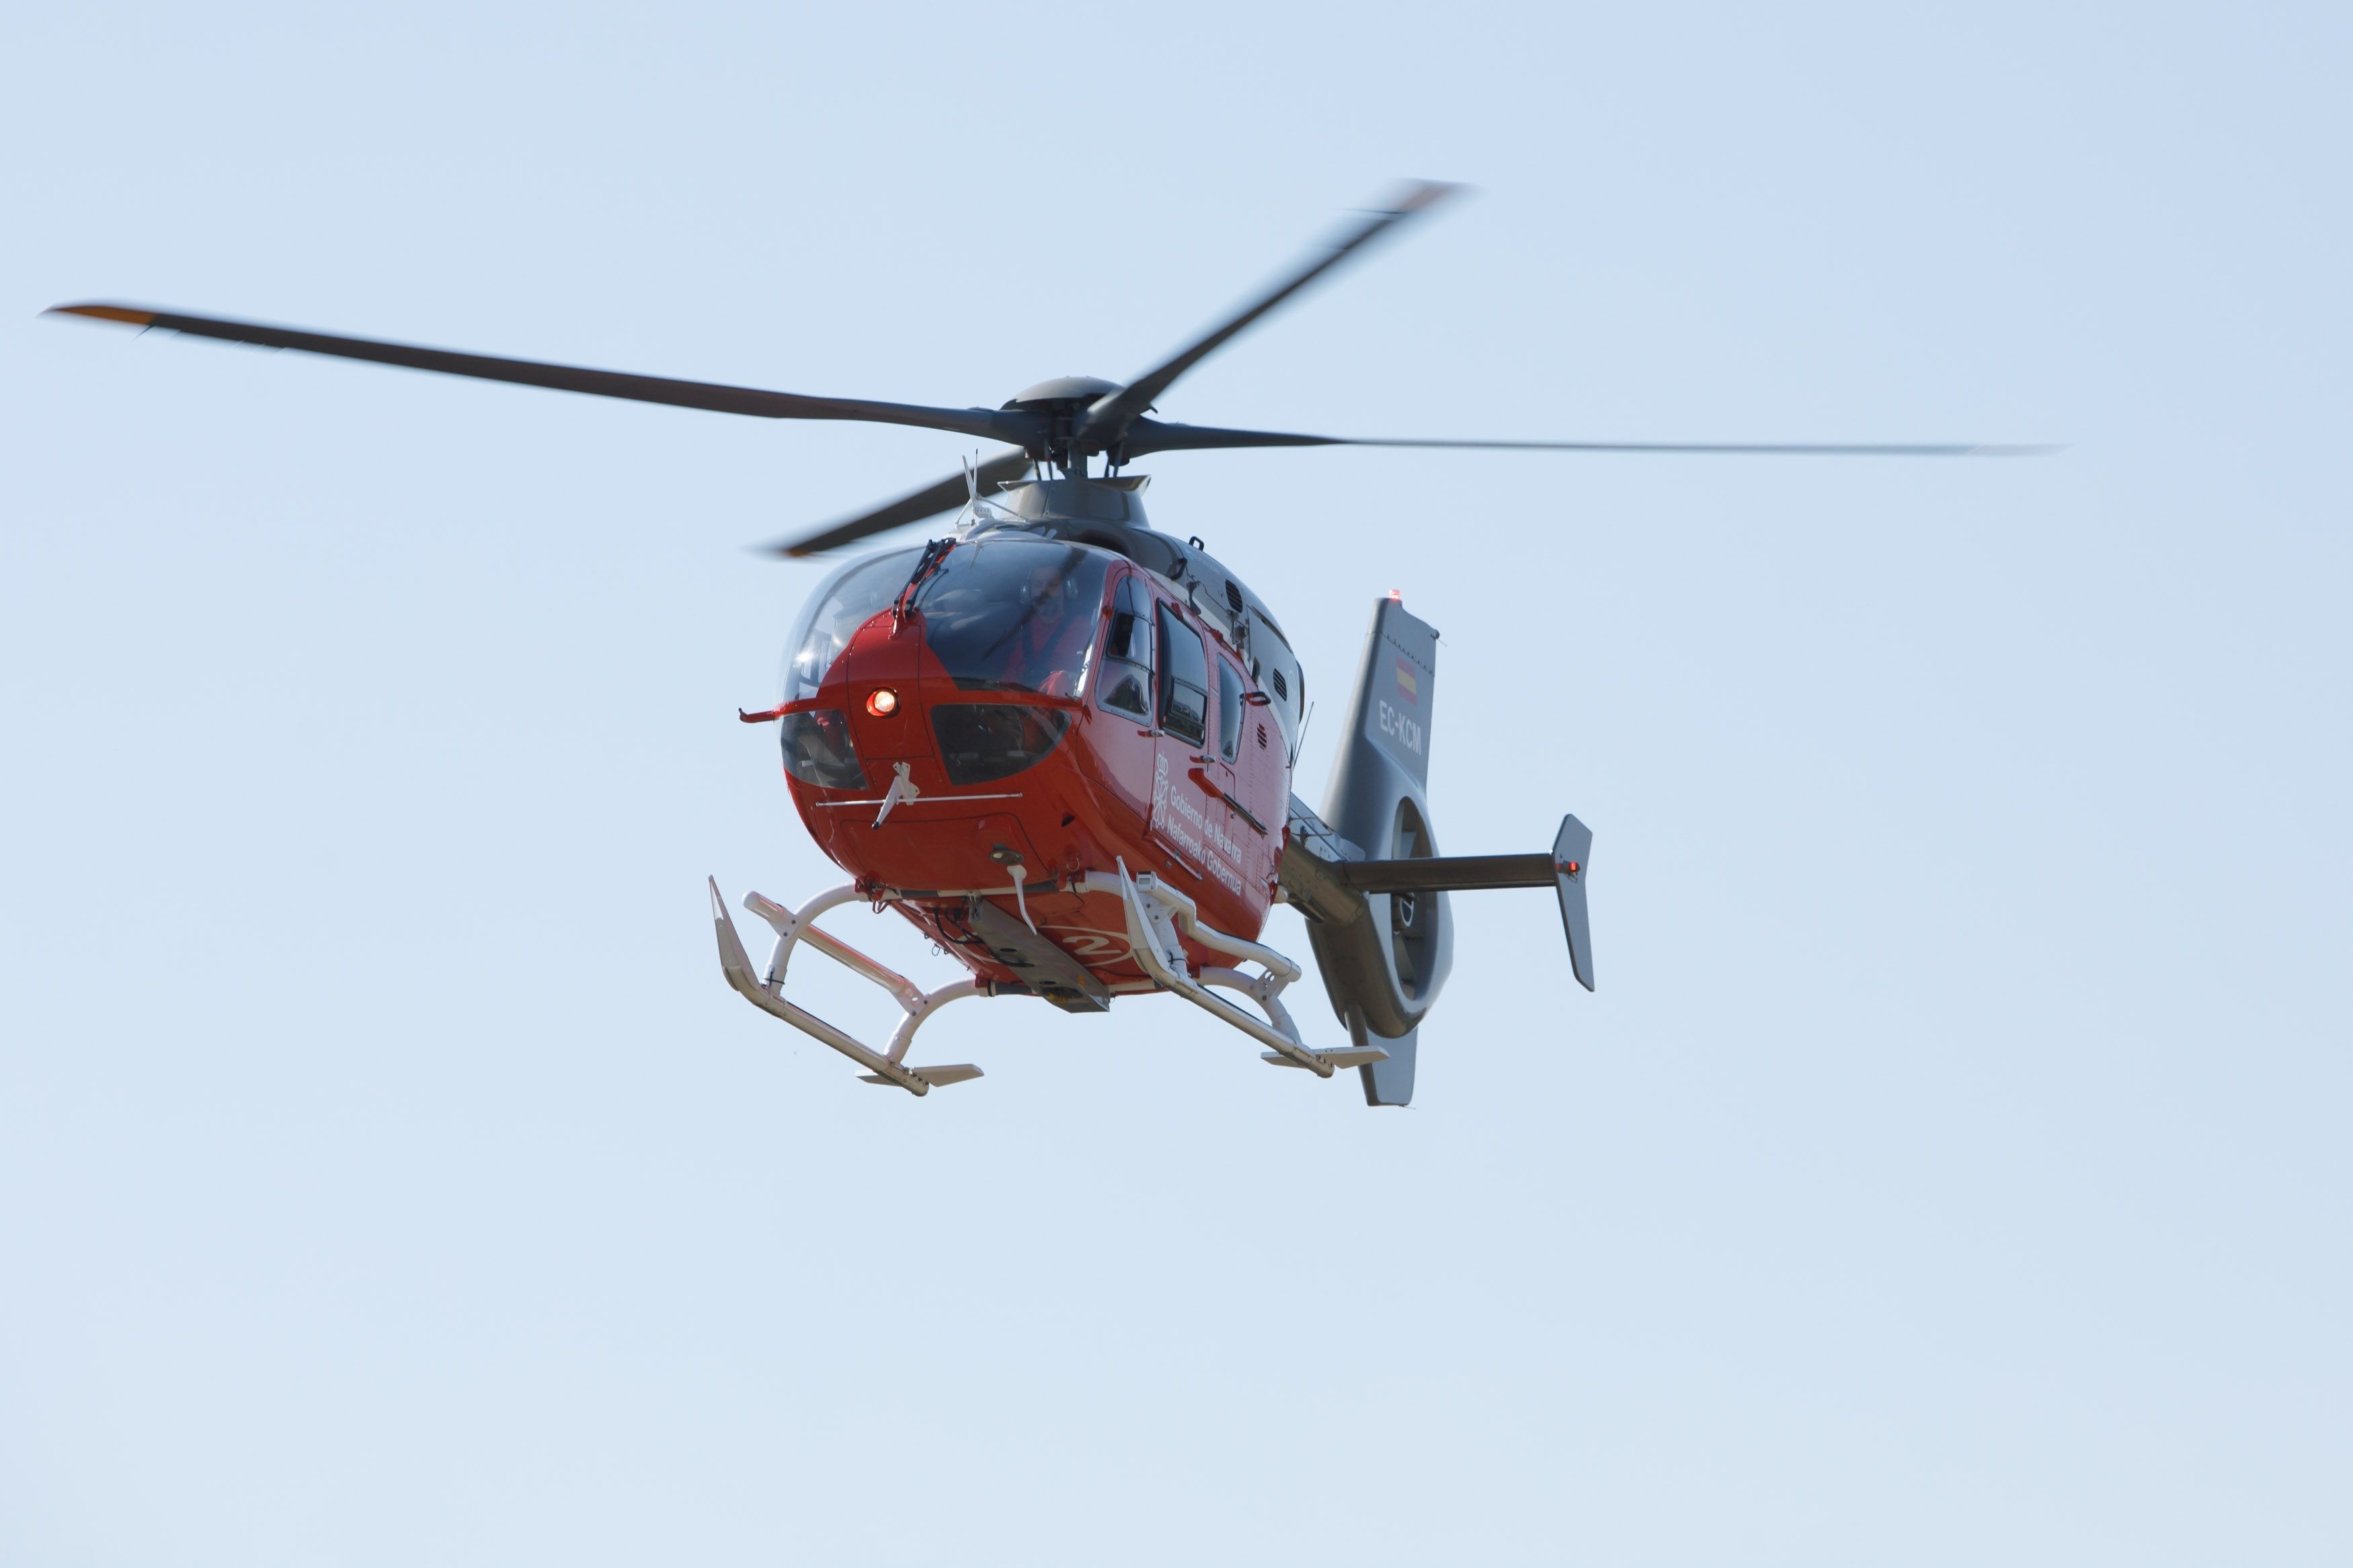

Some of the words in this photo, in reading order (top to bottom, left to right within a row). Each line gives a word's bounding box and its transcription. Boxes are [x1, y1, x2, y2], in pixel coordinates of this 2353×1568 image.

[1380, 699, 1421, 755] EC-KCM
[1167, 815, 1205, 864] Nafarroako
[1207, 850, 1241, 897] Gobernua
[1170, 786, 1203, 829] Gobierno
[1204, 815, 1213, 839] de
[1215, 823, 1241, 864] Navarra
